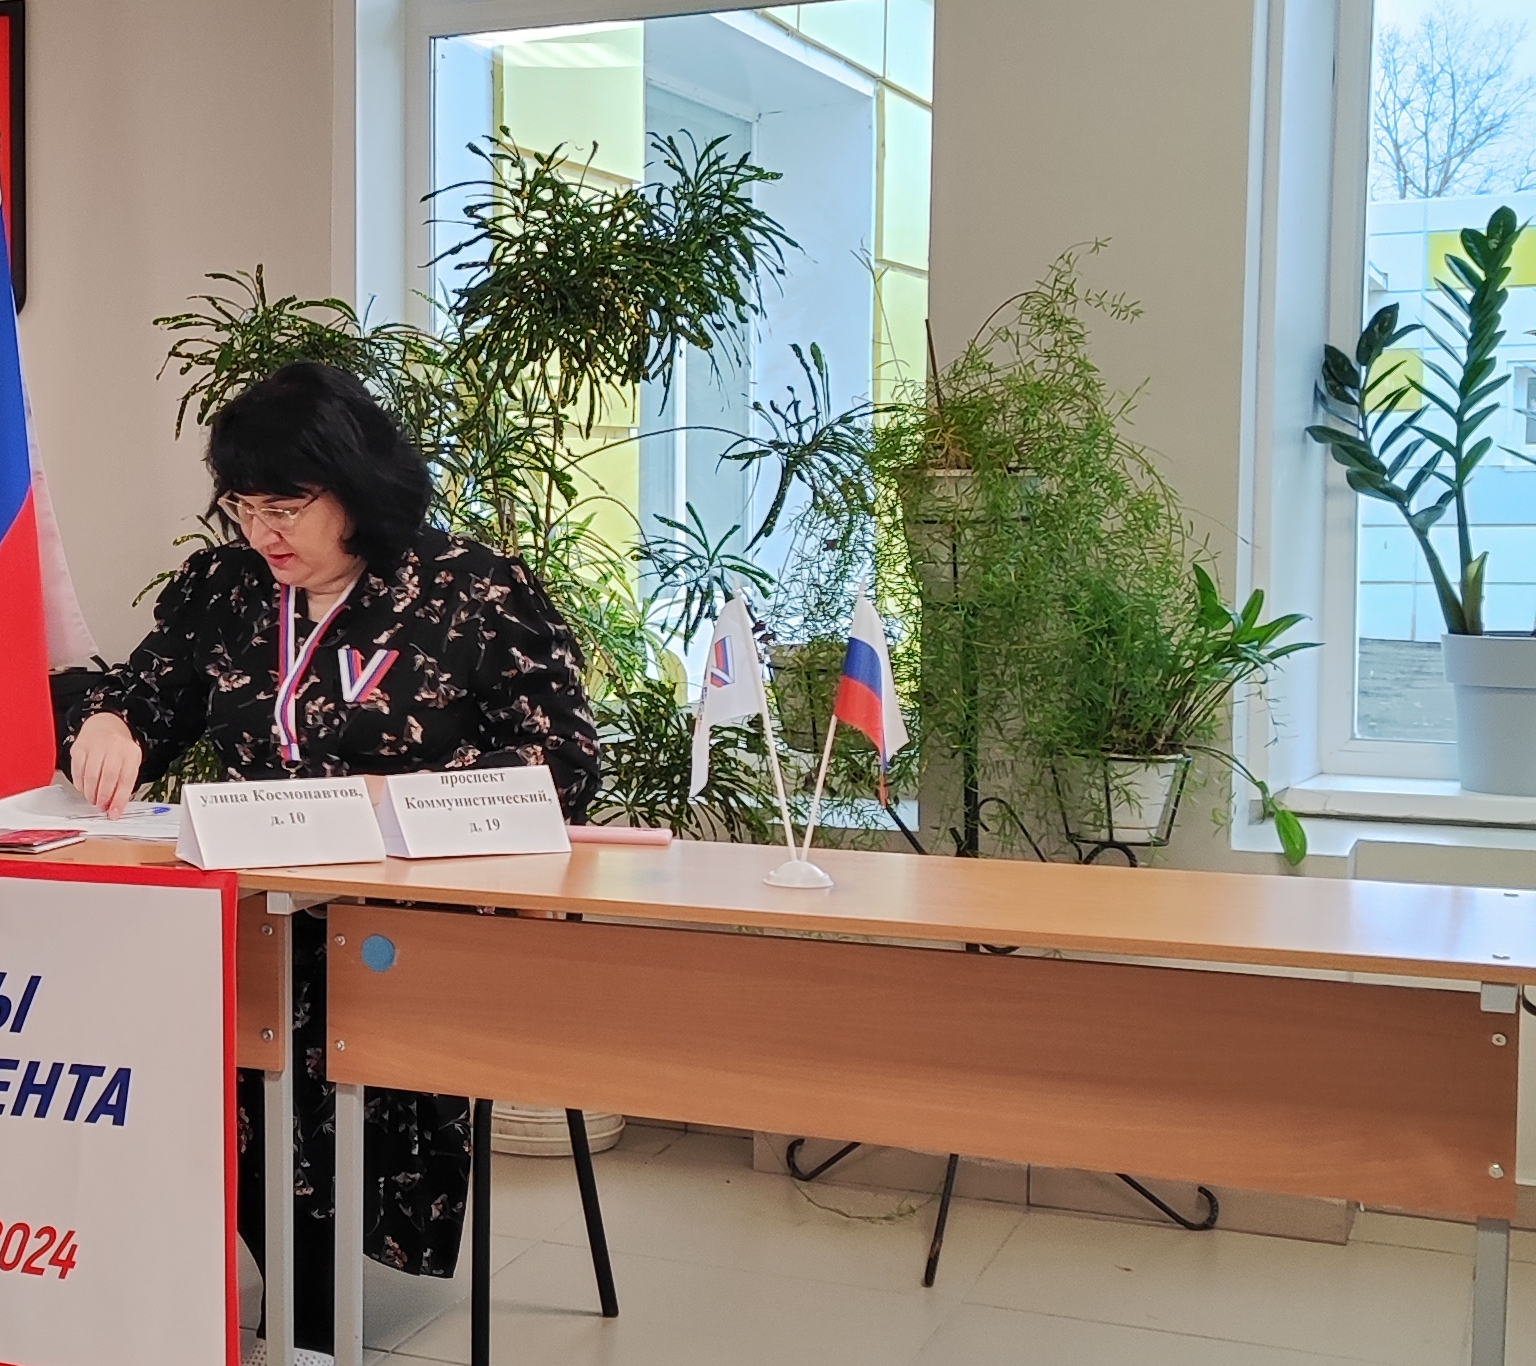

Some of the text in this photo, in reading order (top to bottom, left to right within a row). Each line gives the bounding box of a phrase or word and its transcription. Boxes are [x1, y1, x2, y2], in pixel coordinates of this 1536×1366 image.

[440, 770, 506, 789] проспект
[200, 786, 364, 807] улица Космонавтов,
[404, 790, 553, 812] Коммунистический,
[270, 810, 306, 826] д. 10
[468, 817, 501, 834] д. 19
